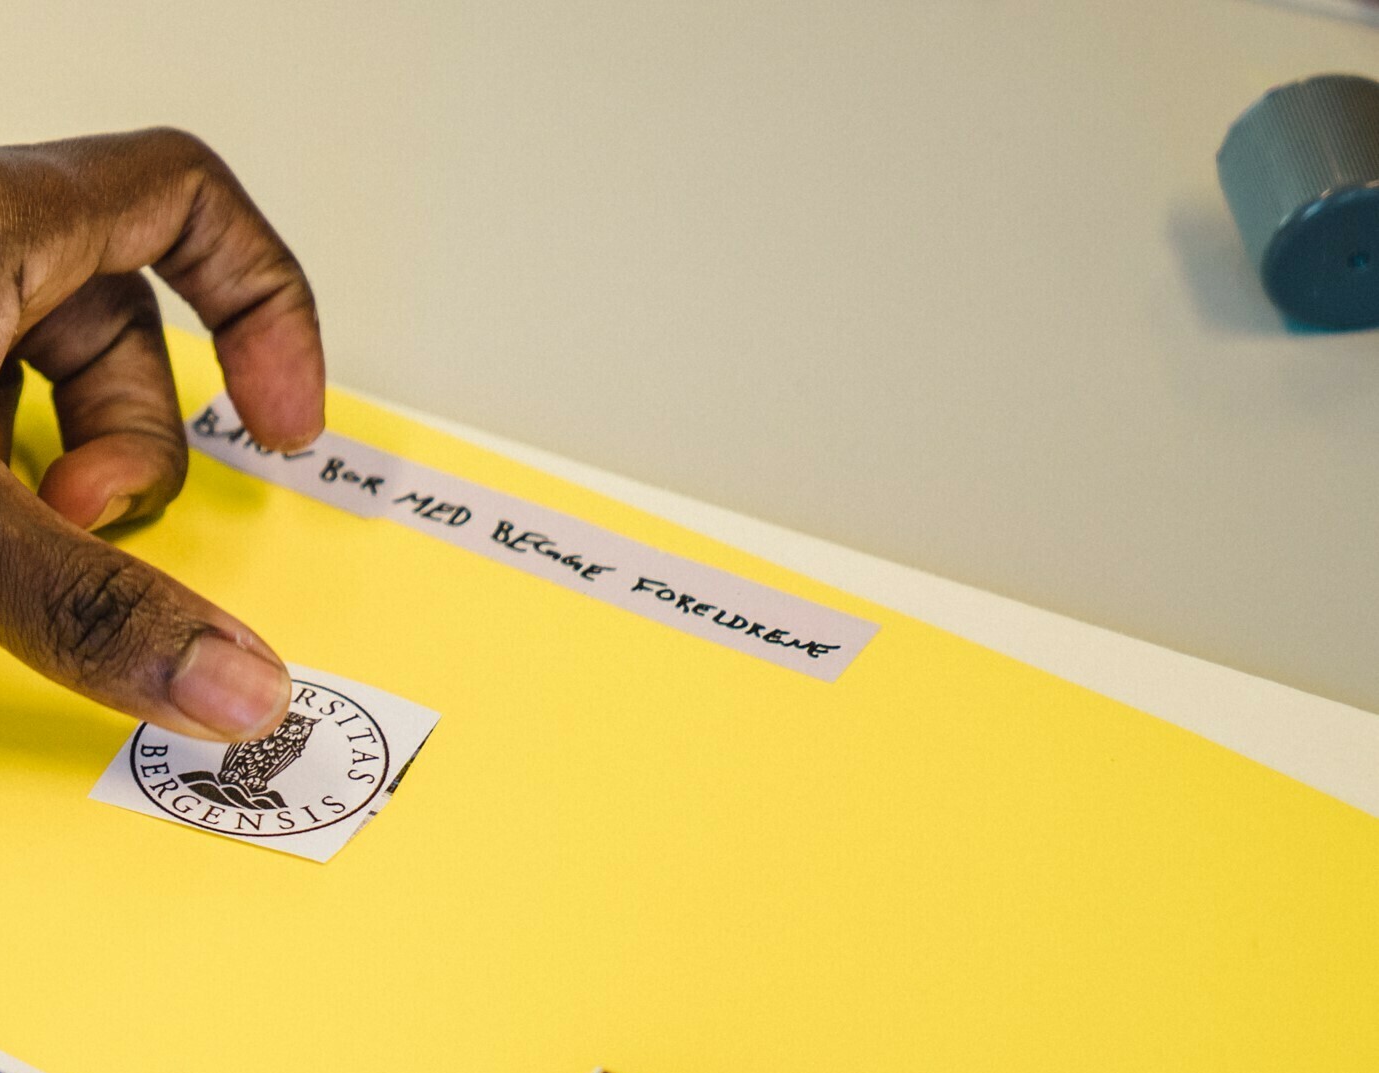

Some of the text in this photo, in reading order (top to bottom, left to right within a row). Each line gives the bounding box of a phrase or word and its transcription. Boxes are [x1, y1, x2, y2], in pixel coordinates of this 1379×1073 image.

[320, 456, 842, 659] BOR MED BEGGE FORELDRENE
[294, 686, 380, 785] RSITAS
[139, 743, 347, 832] BERGENSIS
